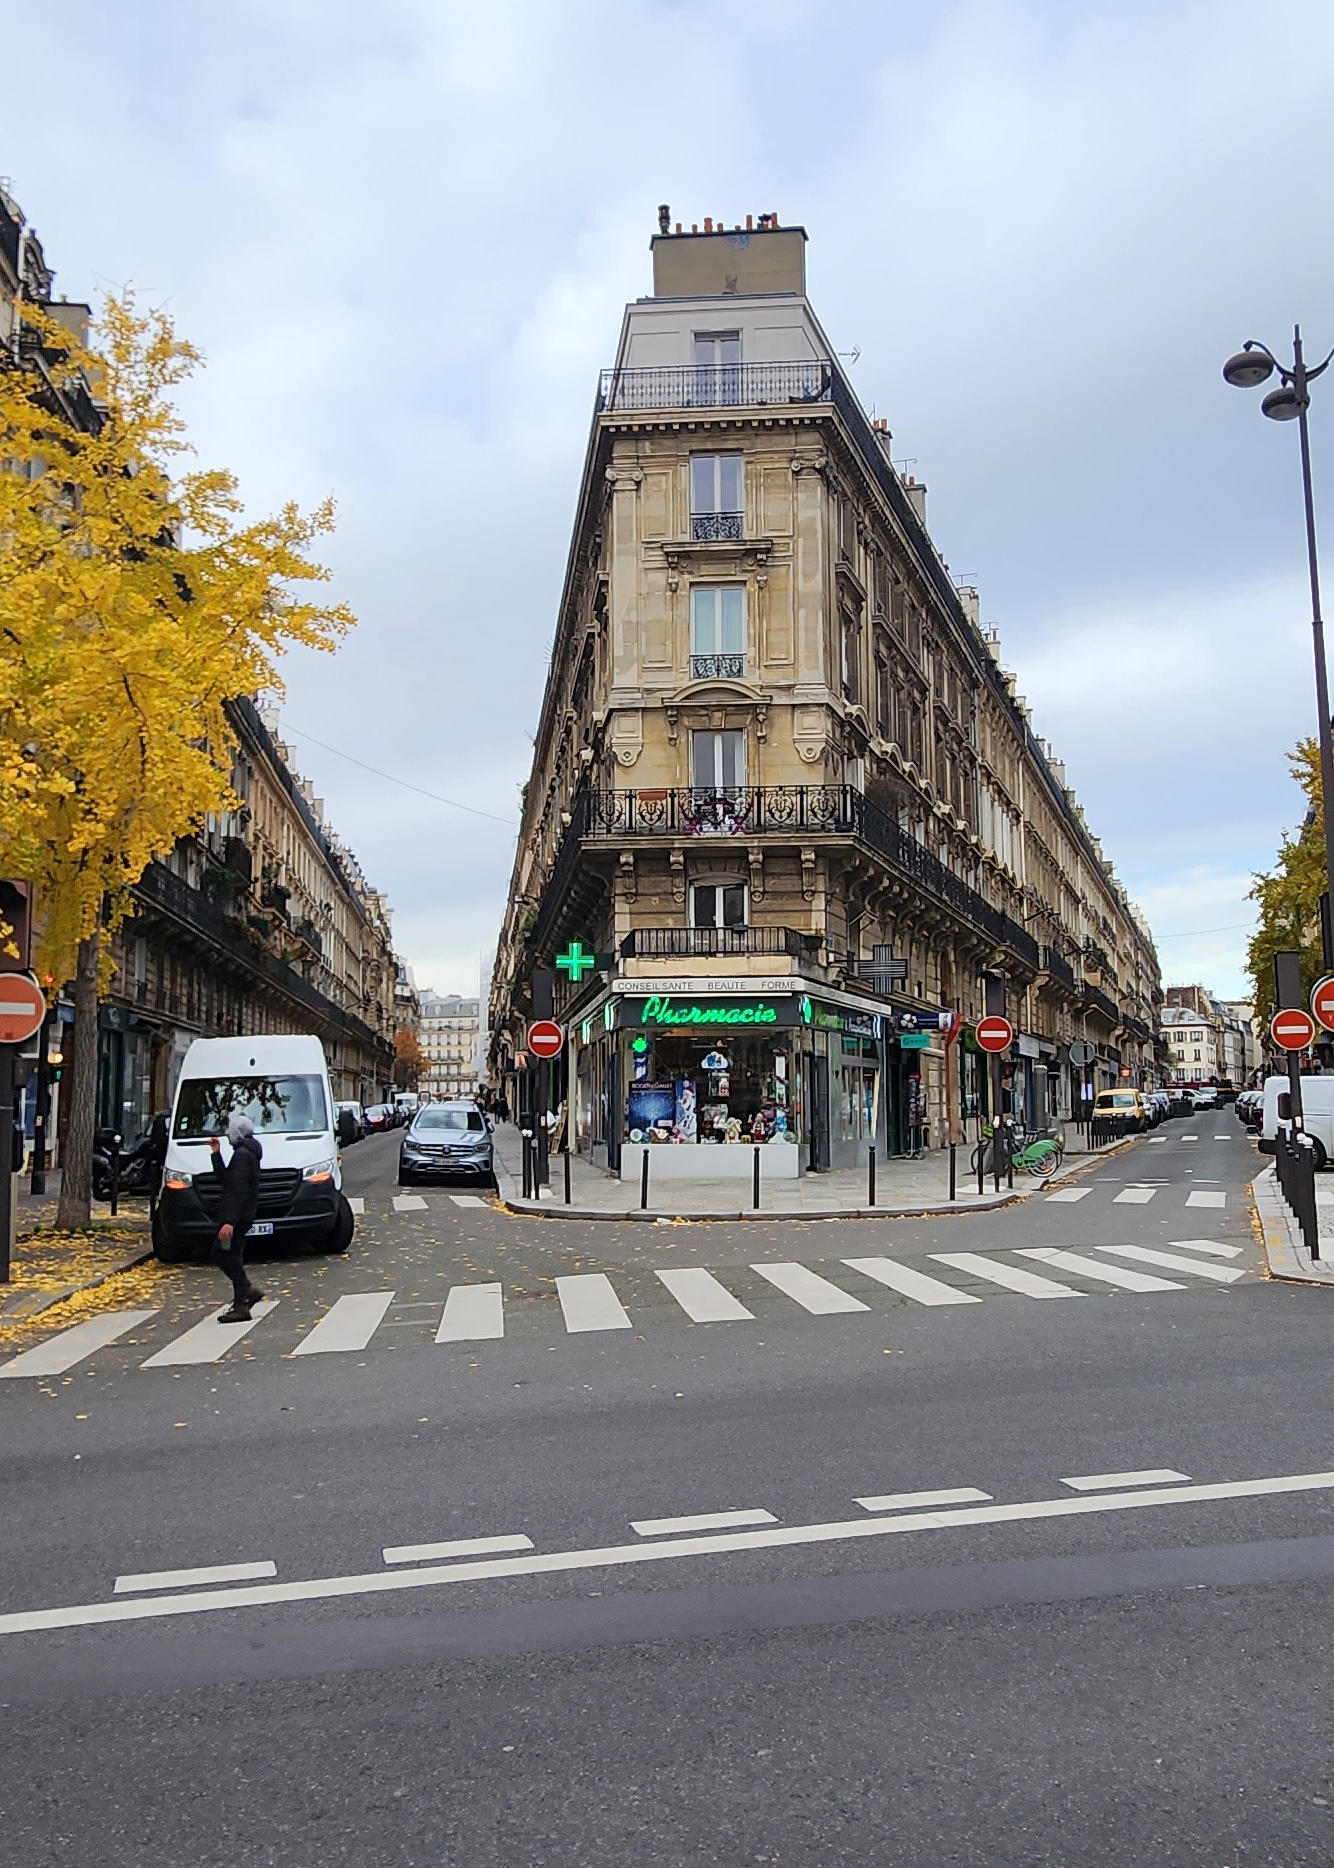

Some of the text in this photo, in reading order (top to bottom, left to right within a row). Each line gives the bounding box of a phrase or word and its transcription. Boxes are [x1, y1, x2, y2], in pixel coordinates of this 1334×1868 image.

[618, 981, 796, 990] CONSEIL SANTE BEAUTE FORME
[641, 995, 777, 1025] Pharmacie
